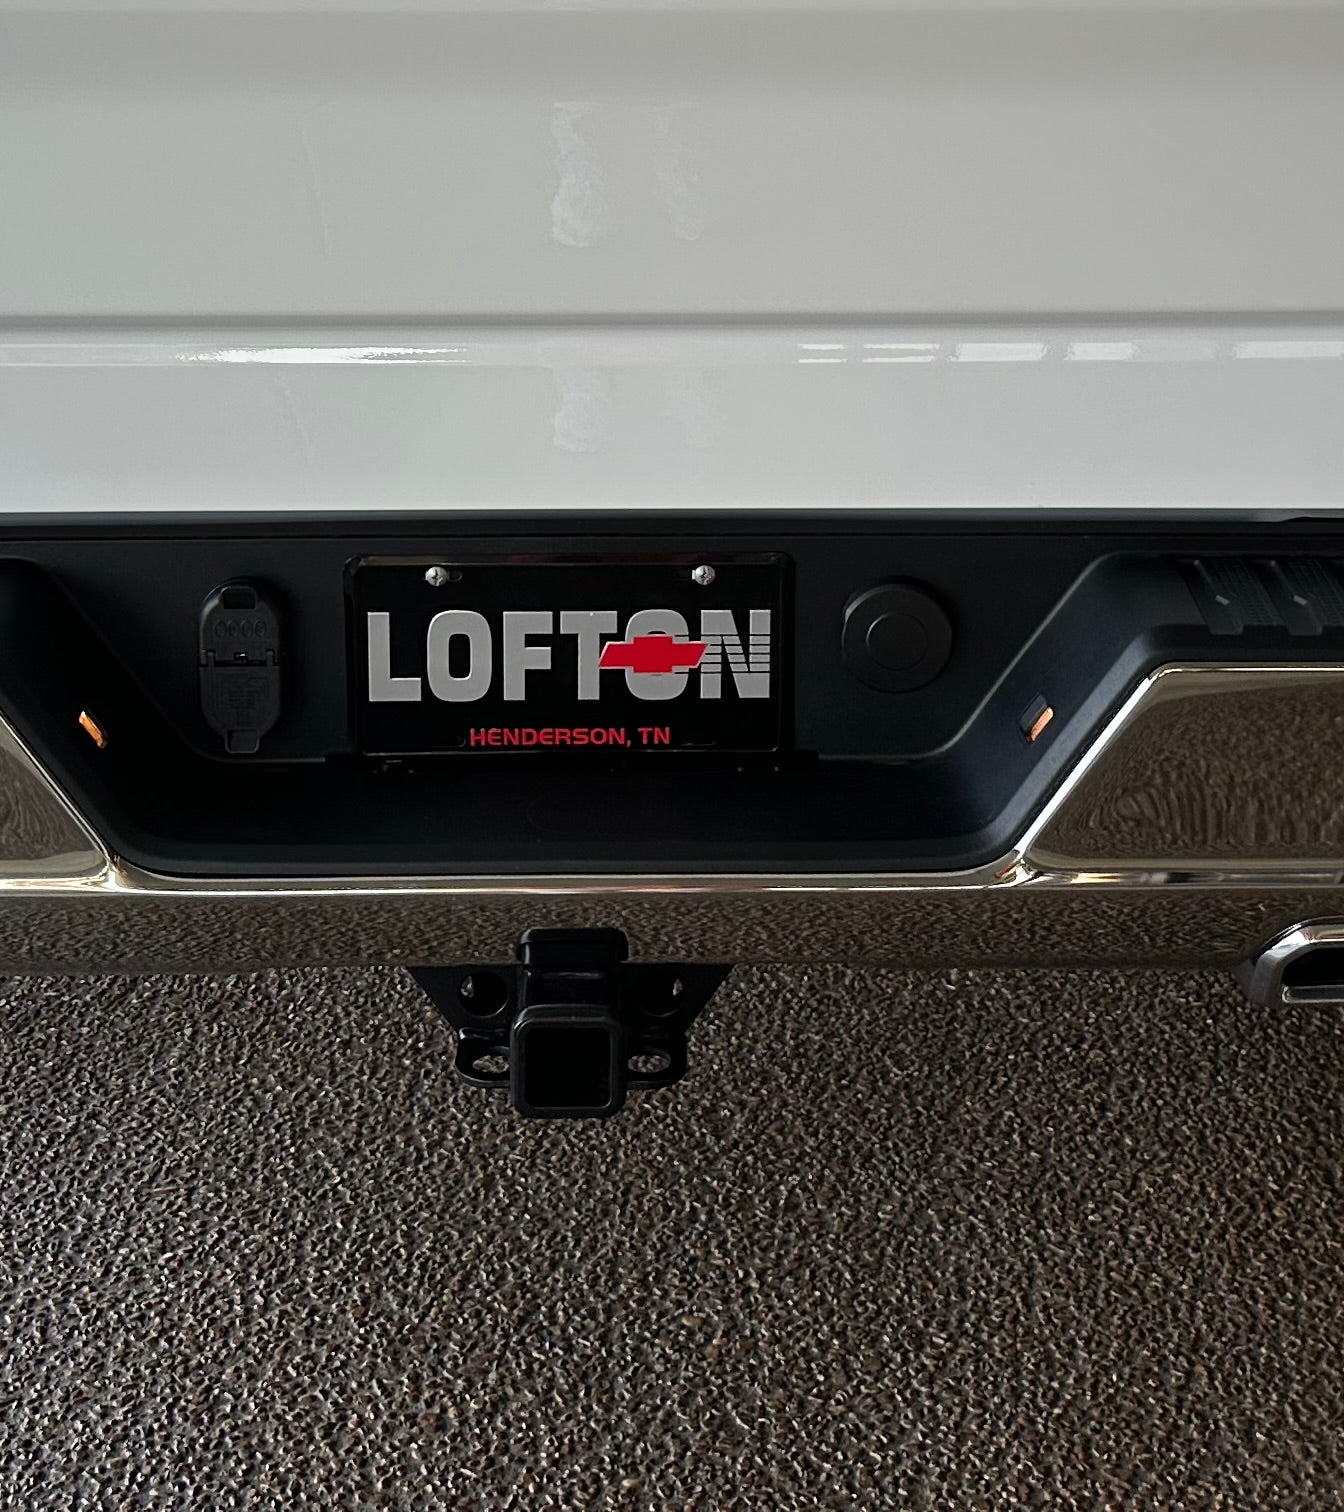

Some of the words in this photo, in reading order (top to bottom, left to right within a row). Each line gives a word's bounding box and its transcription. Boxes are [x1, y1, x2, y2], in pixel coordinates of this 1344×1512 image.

[367, 609, 771, 702] LOFTON
[470, 727, 631, 748] HENDERSON,
[638, 727, 670, 745] TN
